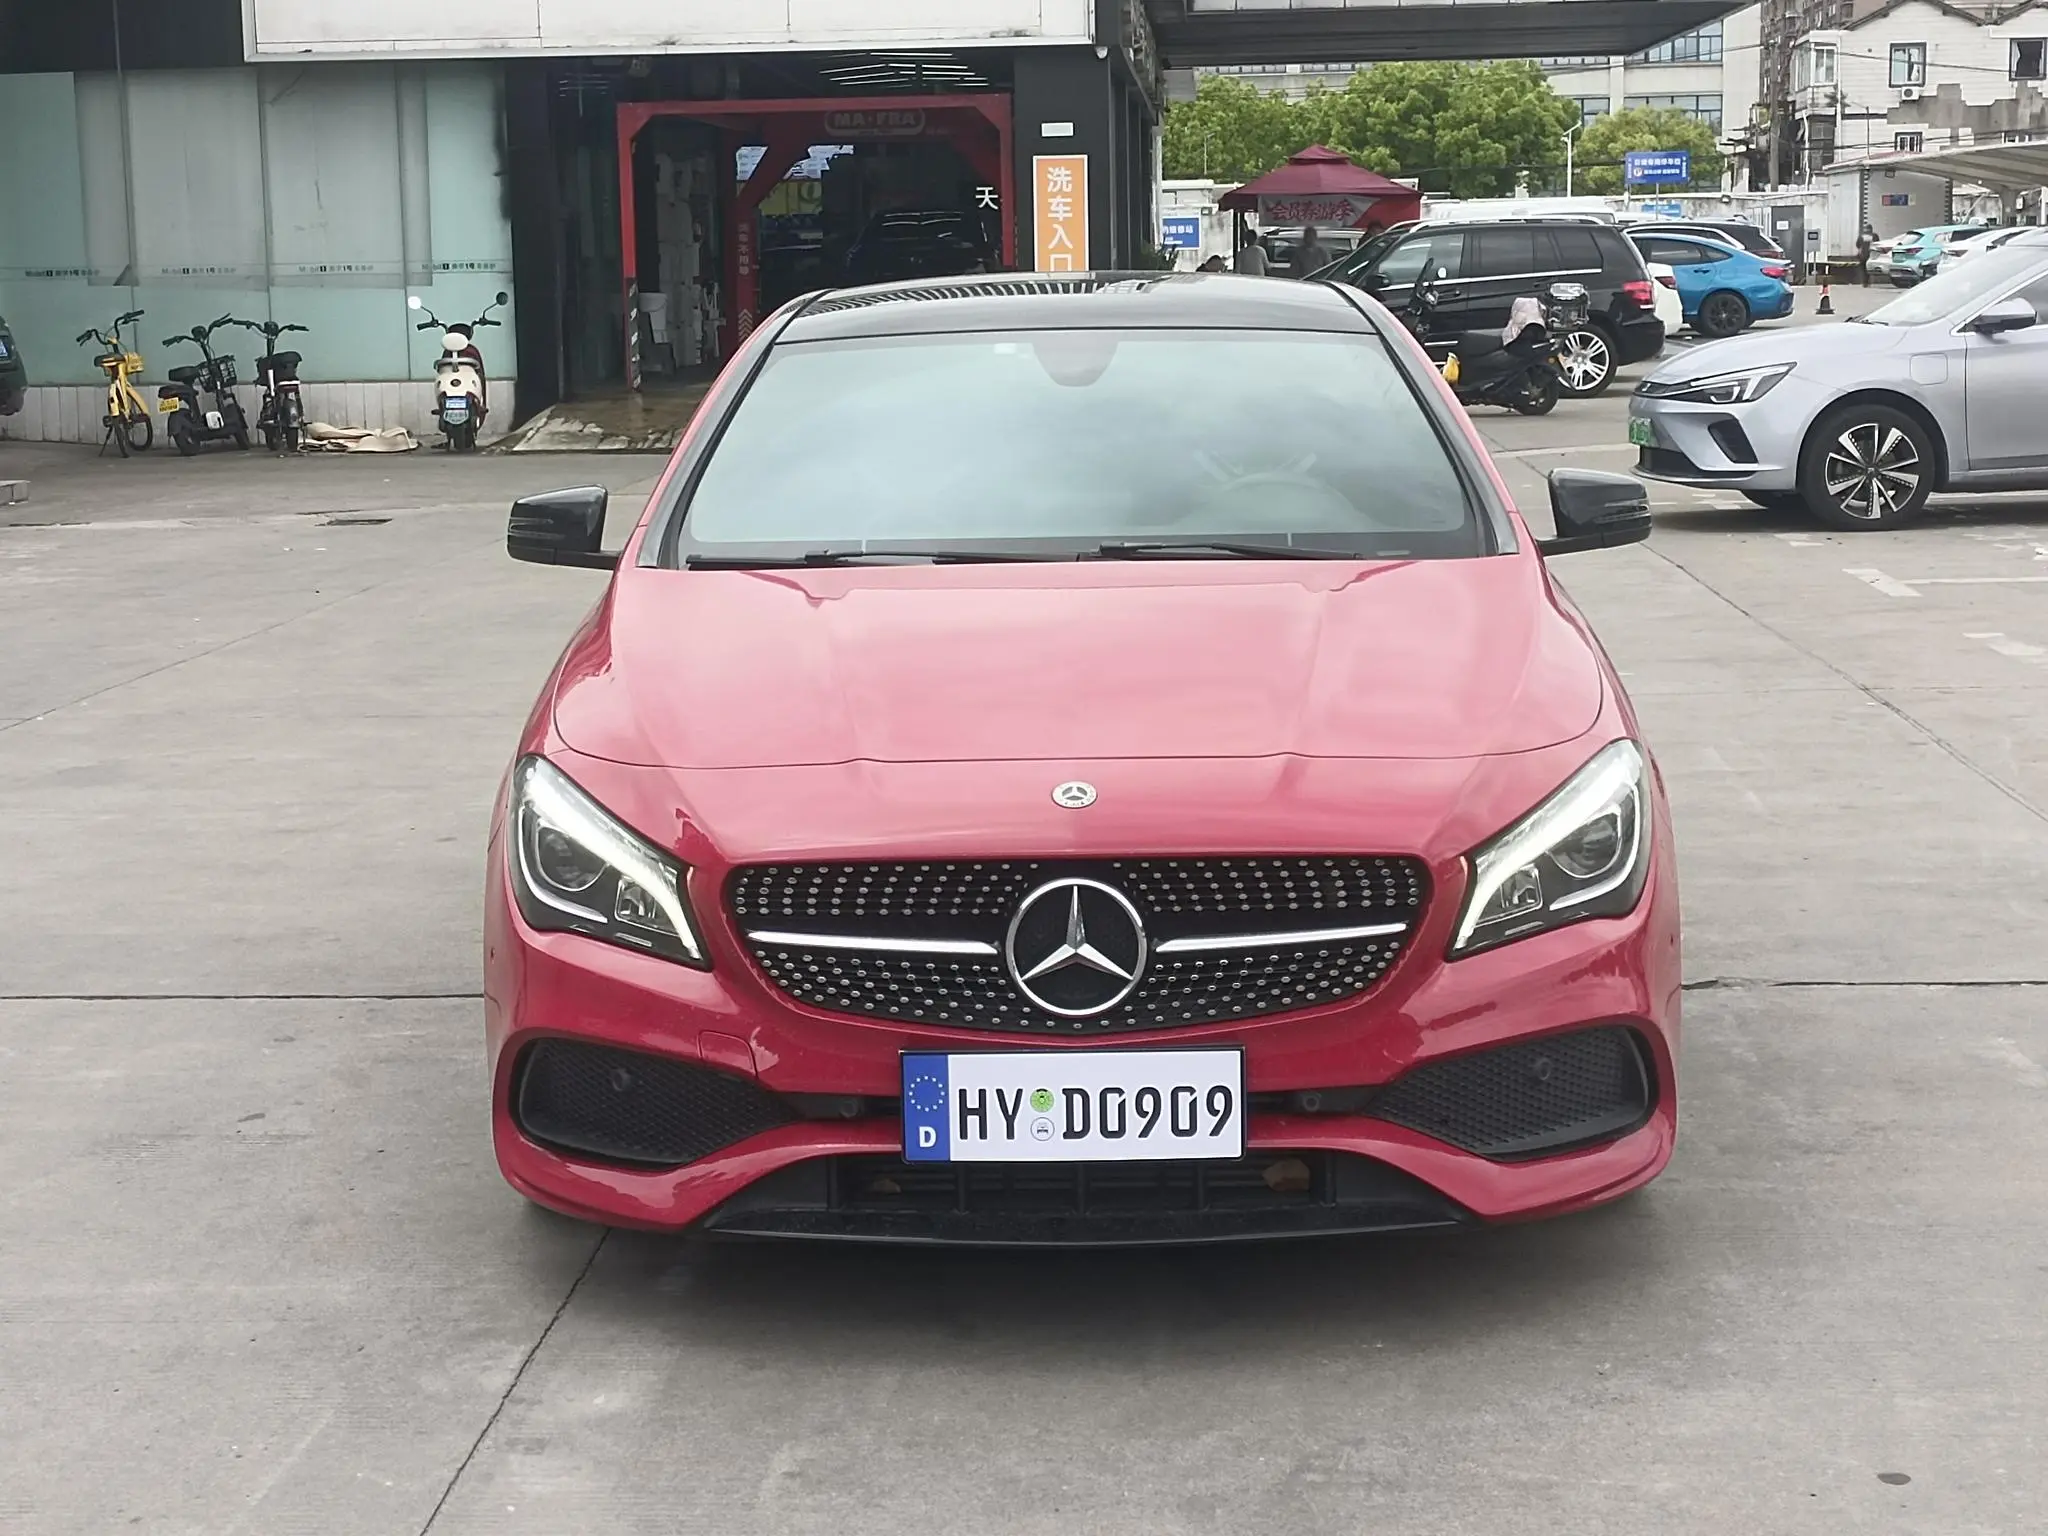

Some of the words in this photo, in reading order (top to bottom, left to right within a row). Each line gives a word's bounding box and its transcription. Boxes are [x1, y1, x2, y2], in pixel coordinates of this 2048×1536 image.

[975, 186, 999, 210] 天
[1047, 166, 1074, 272] 洗车入口
[957, 1087, 1024, 1140] HY
[1062, 1085, 1234, 1140] D0909
[919, 1126, 937, 1148] D
